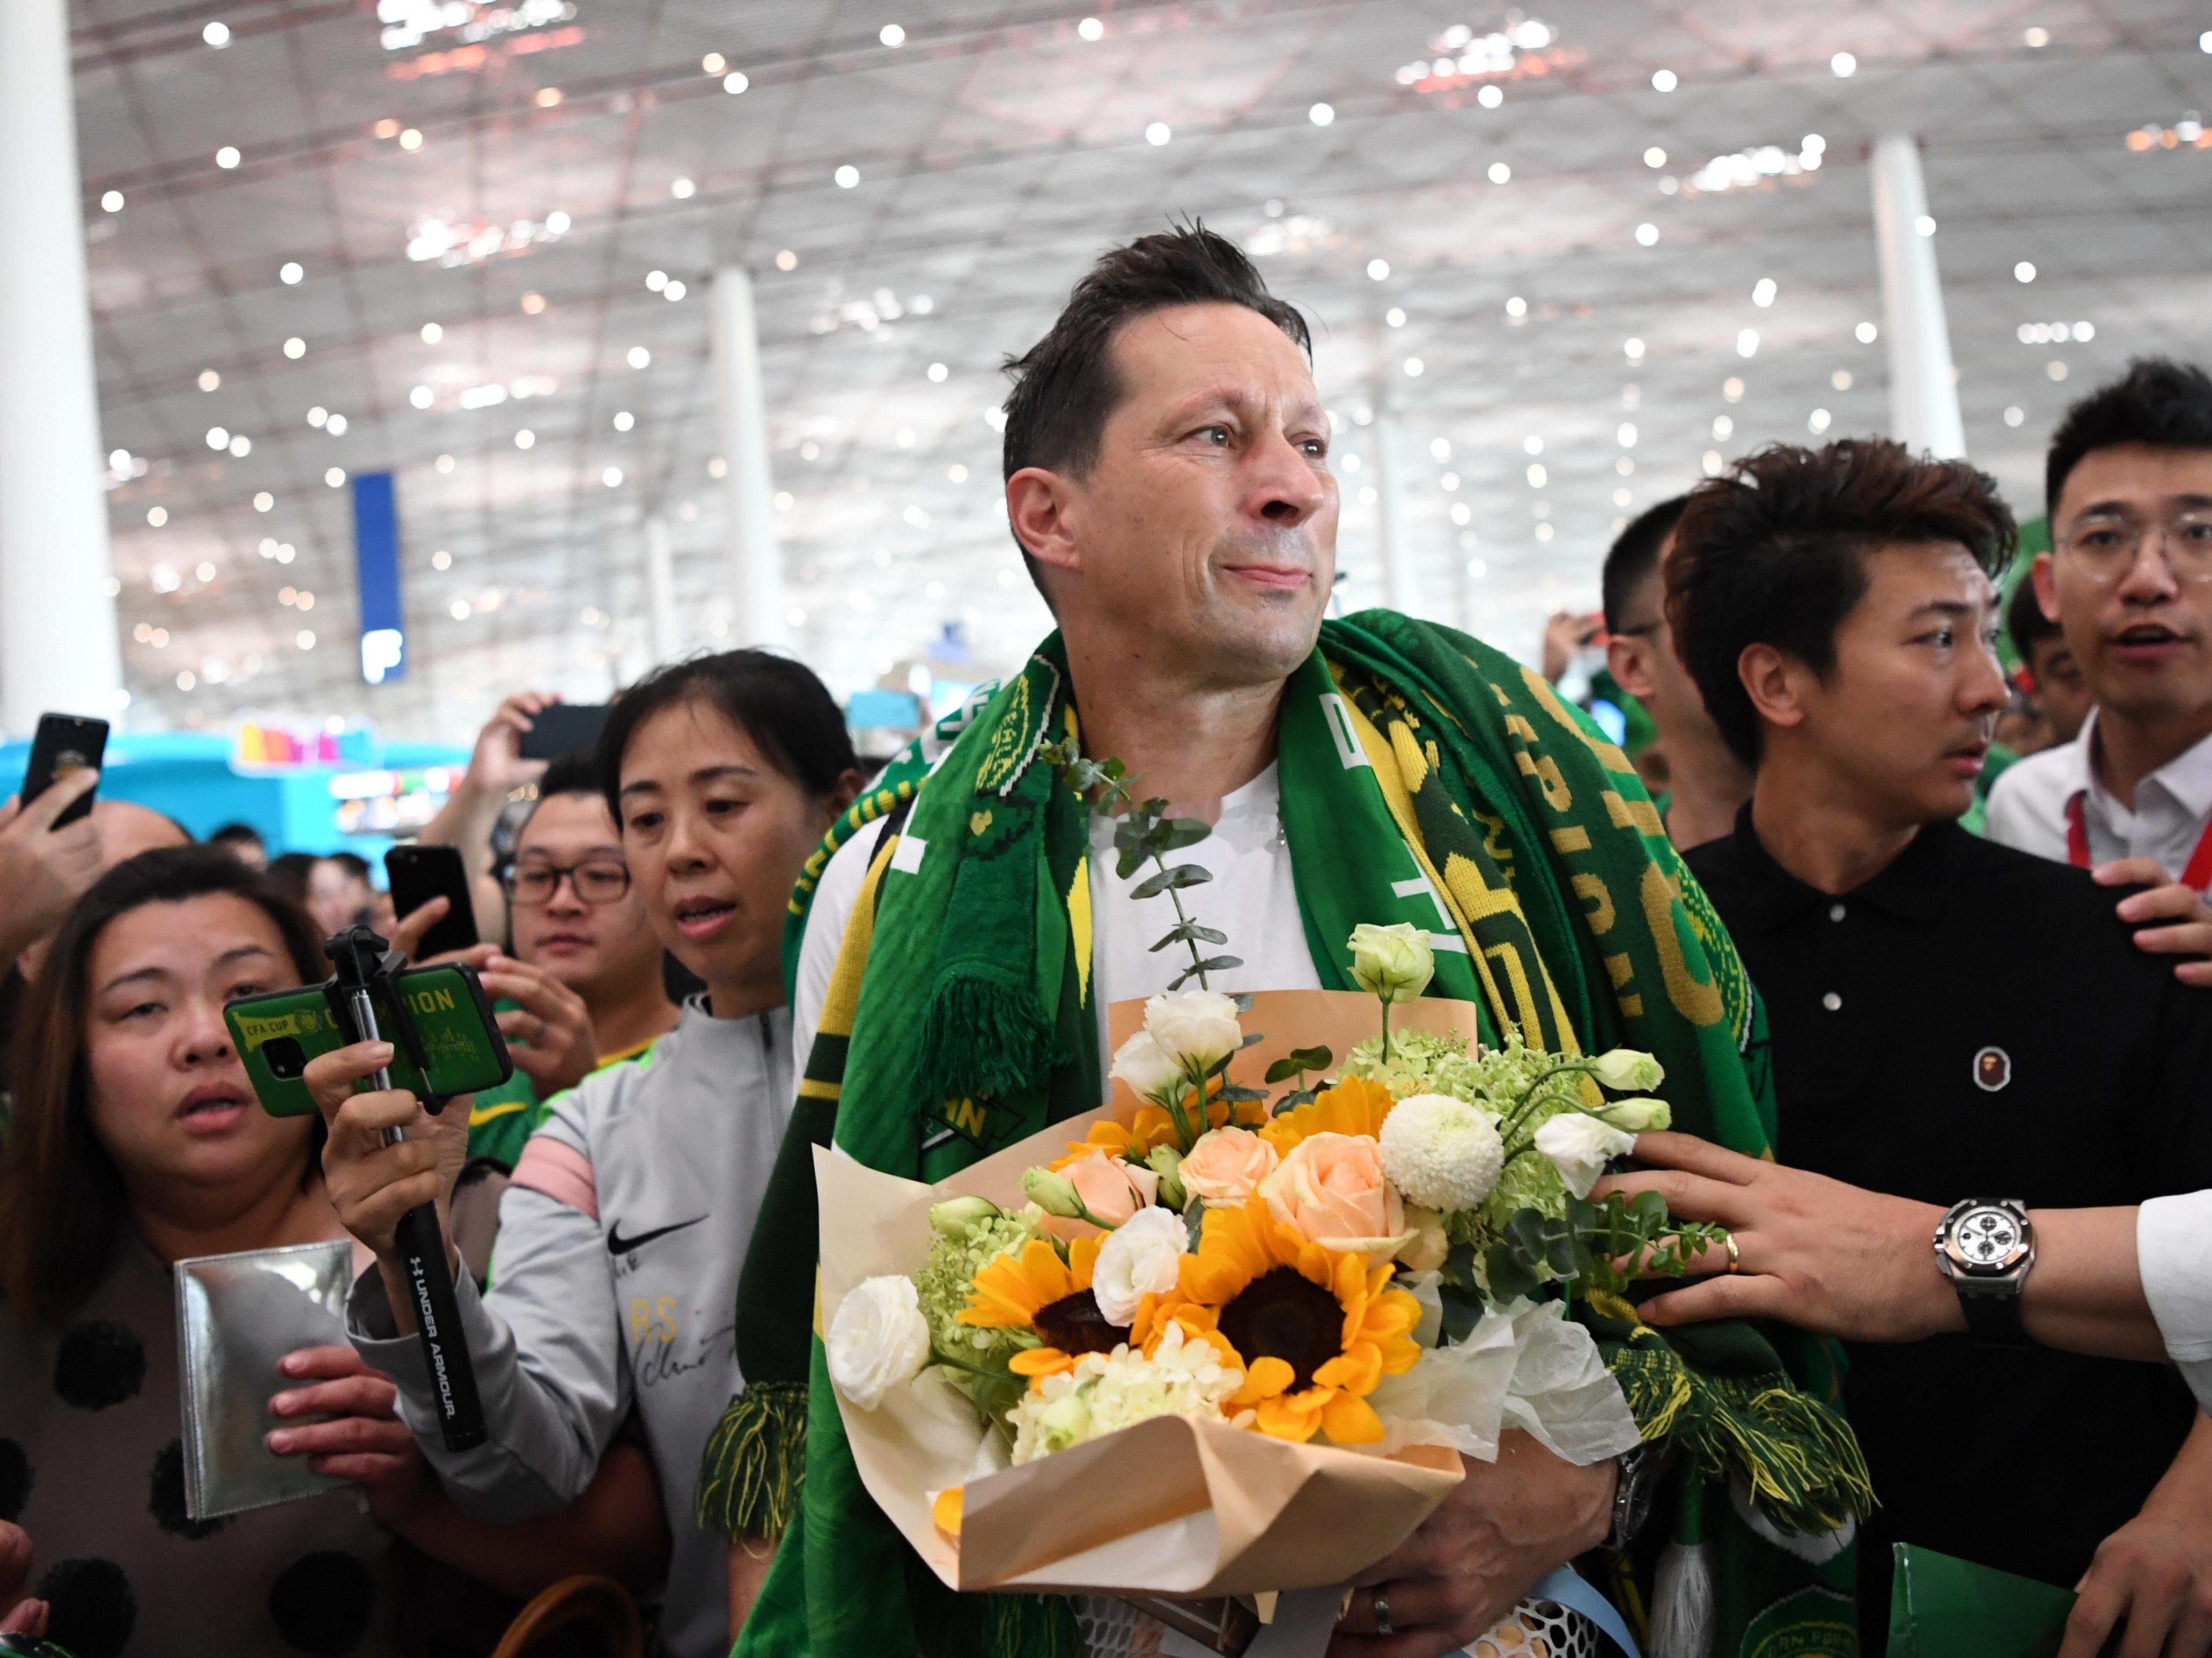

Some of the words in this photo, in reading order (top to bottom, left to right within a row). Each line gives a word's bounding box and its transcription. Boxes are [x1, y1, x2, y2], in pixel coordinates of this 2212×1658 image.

[247, 1025, 267, 1036] CFA
[269, 1020, 289, 1032] CUP
[415, 1279, 438, 1338] UNDER
